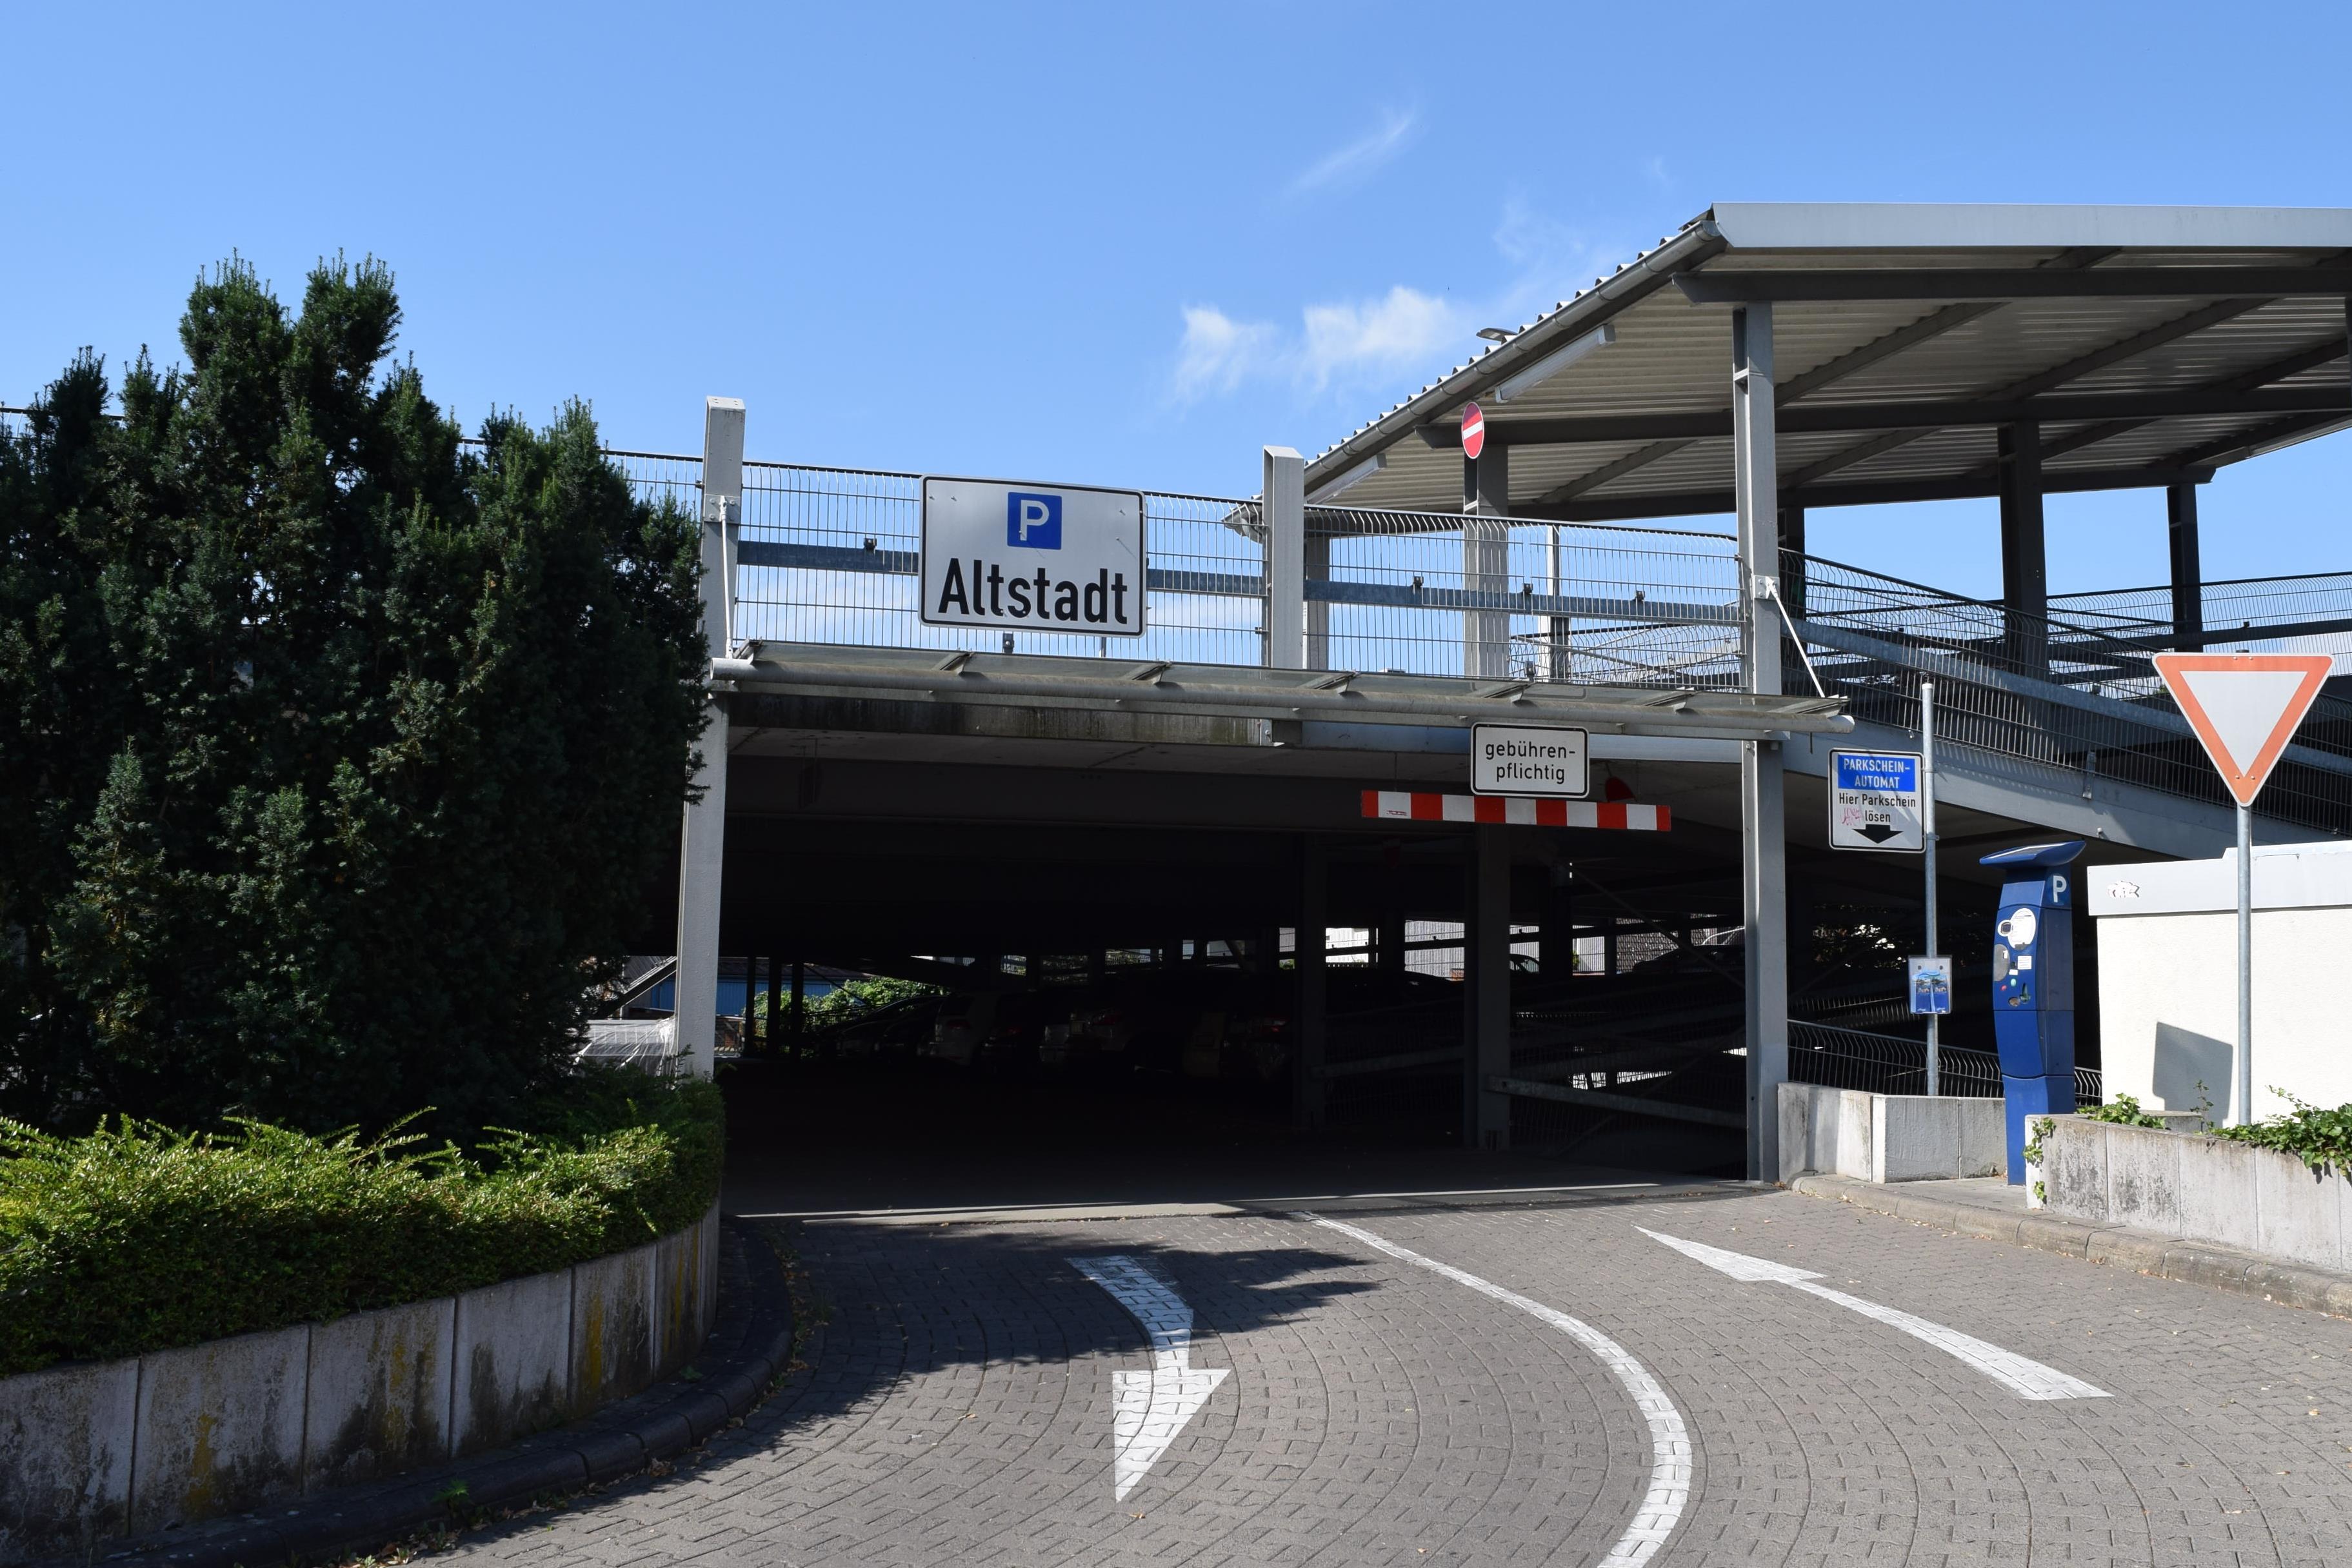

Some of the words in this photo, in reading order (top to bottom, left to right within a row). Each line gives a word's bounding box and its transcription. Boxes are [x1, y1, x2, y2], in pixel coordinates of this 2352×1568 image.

[1020, 499, 1050, 541] P
[937, 557, 1128, 625] Altstadt
[1485, 740, 1576, 760] gebühren-
[1496, 762, 1565, 785] pflichtig
[1844, 758, 1910, 773] PARKSCHEIN-
[1854, 775, 1900, 789] AUTOMAT
[1839, 793, 1859, 805] Hier
[1862, 794, 1916, 808] Parkschein
[1865, 810, 1891, 822] lösen
[2053, 875, 2067, 903] P
